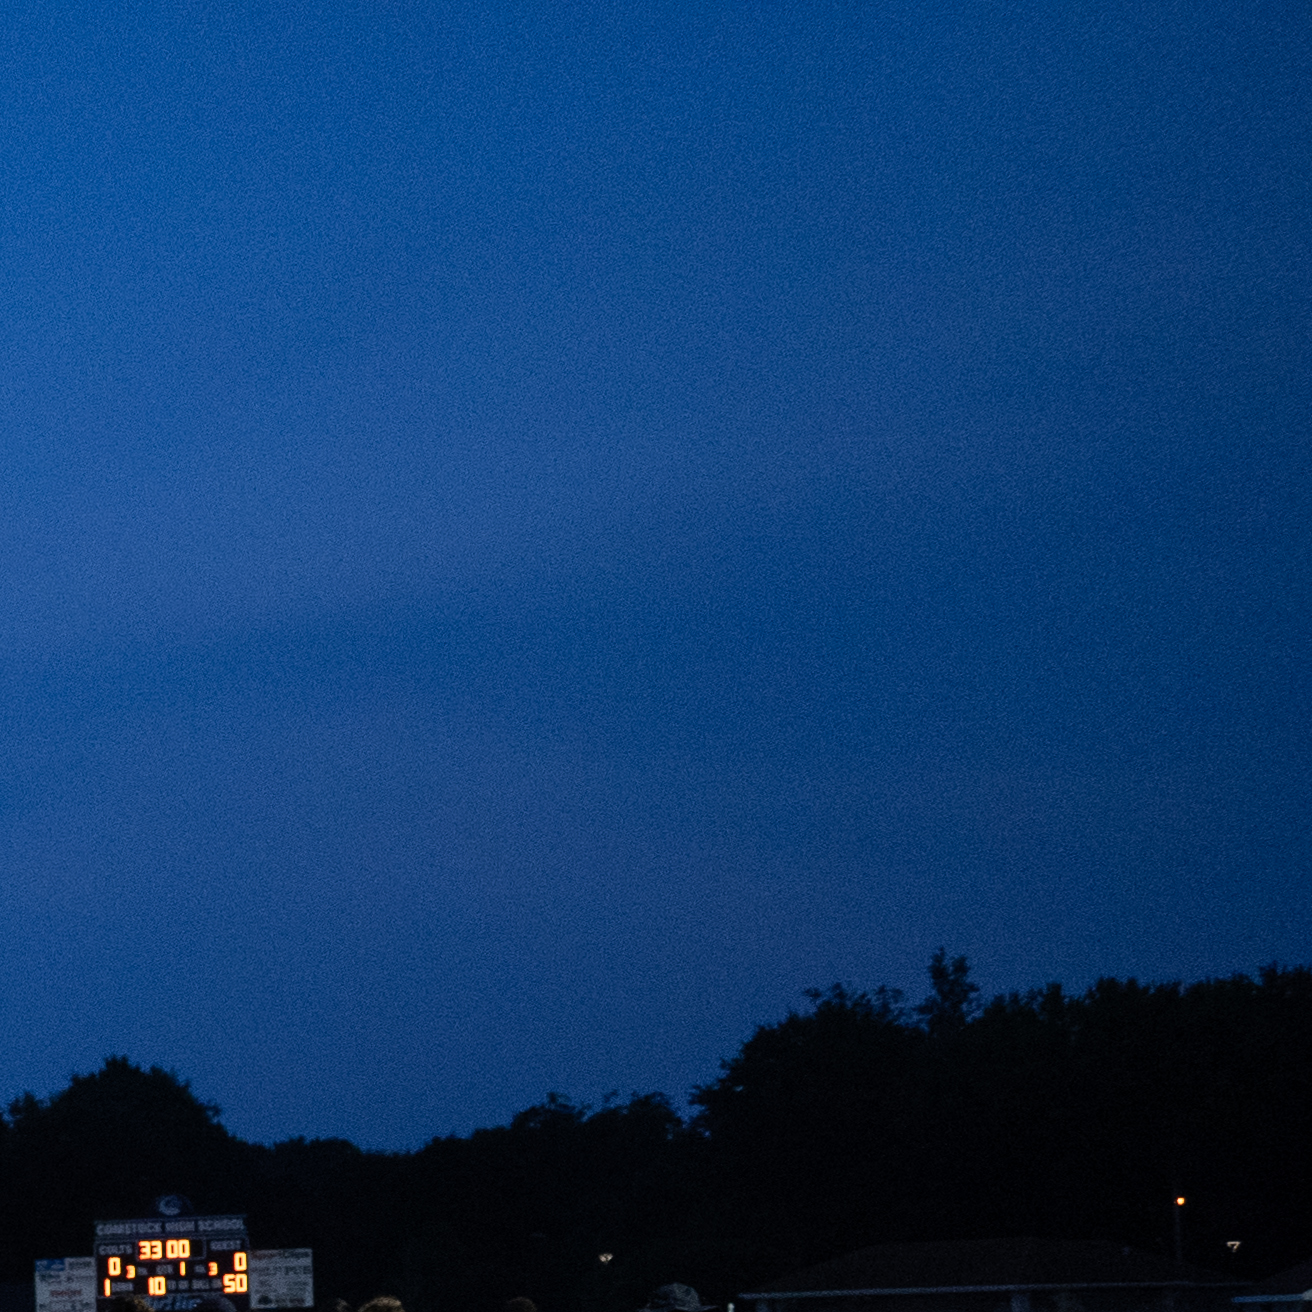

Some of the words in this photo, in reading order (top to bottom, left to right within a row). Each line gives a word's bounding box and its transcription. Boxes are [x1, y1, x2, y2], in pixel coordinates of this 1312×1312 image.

[98, 1244, 133, 1256] COLTS
[107, 1256, 122, 1277] 0
[179, 1261, 187, 1277] 1
[207, 1261, 218, 1277] 3
[233, 1251, 247, 1272] 0
[103, 1278, 111, 1298] 1
[147, 1276, 167, 1297] 10
[222, 1273, 249, 1294] 50
